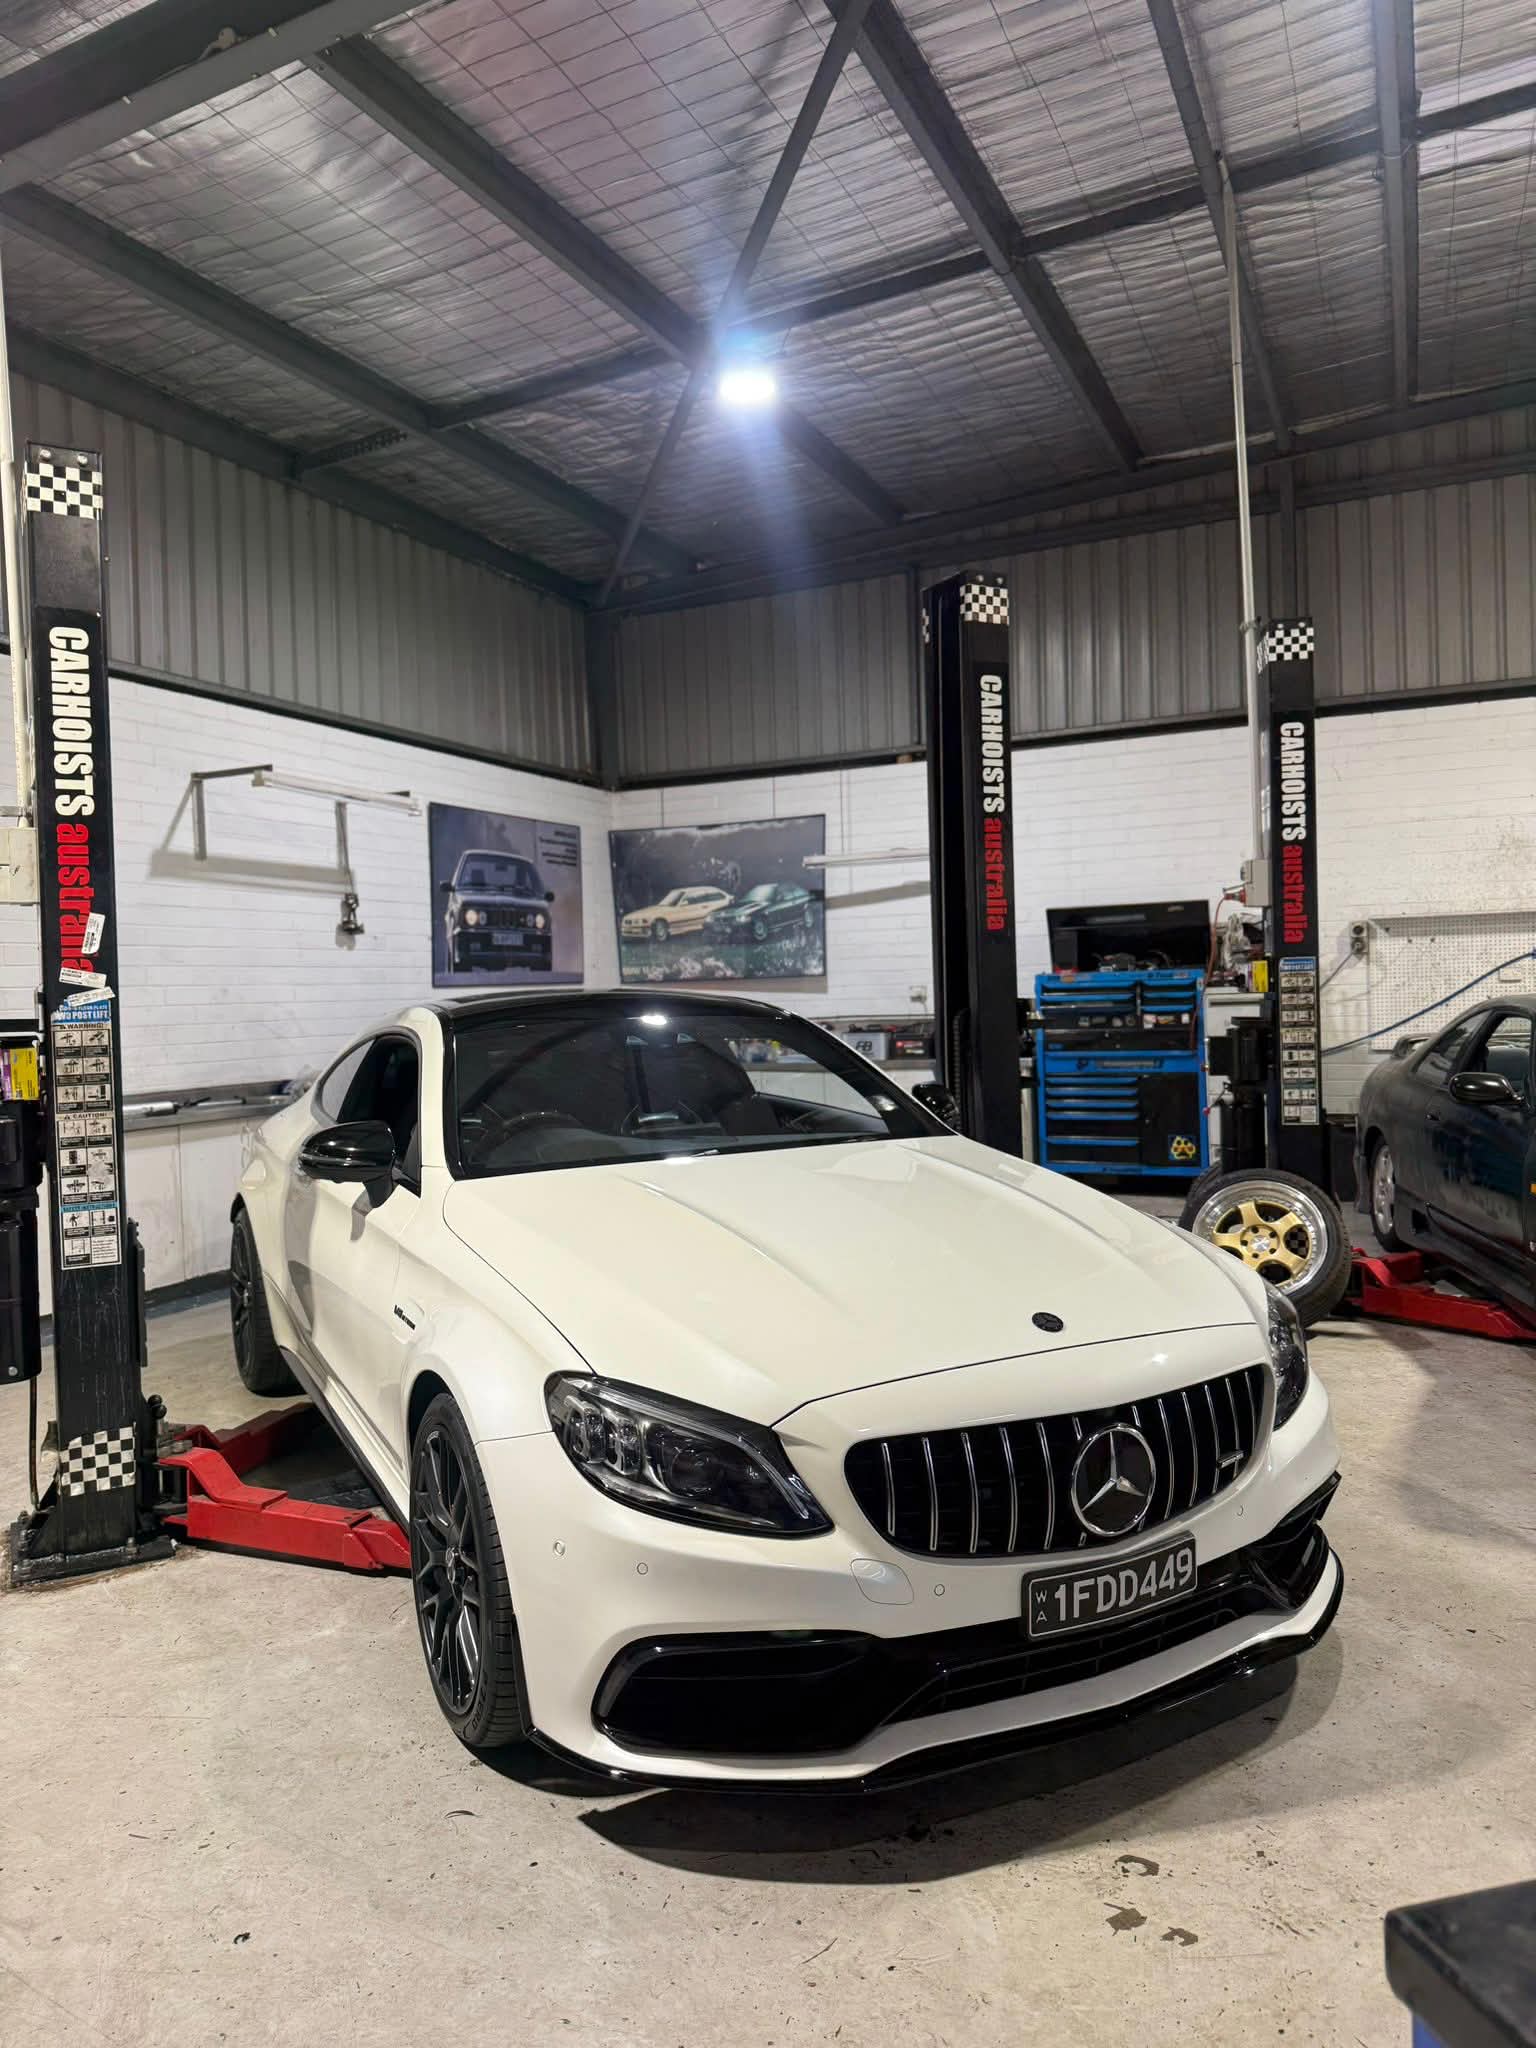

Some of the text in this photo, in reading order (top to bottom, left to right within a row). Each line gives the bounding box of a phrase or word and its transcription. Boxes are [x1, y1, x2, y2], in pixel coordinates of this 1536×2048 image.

[49, 626, 95, 816] CARHOISTS
[980, 674, 1008, 931] CARHOISTS australia
[1280, 721, 1307, 842] CARHOISTS
[1283, 844, 1309, 944] australia
[72, 1010, 92, 1020] POST
[1054, 1547, 1193, 1622] 1FDD449
